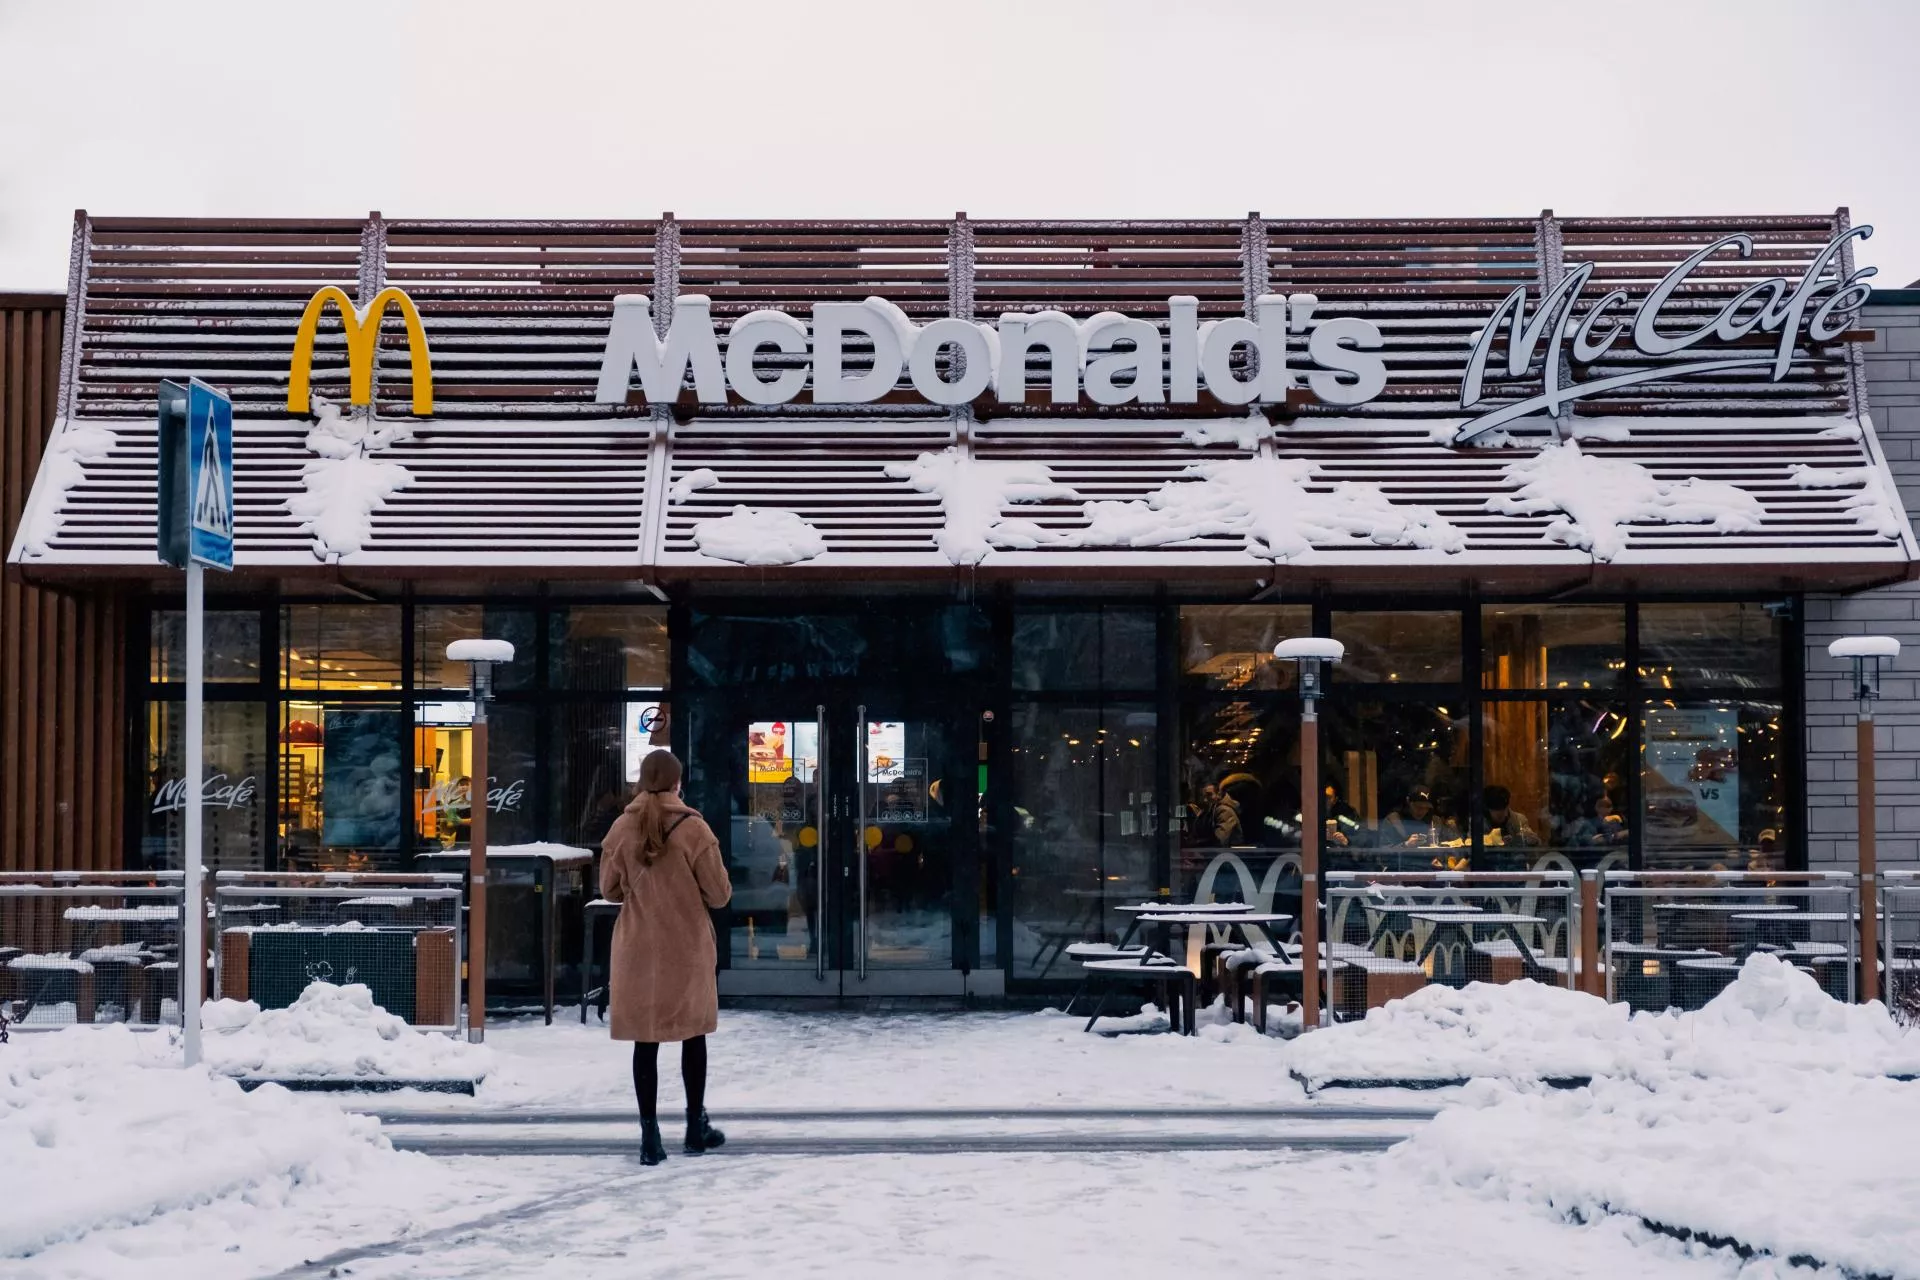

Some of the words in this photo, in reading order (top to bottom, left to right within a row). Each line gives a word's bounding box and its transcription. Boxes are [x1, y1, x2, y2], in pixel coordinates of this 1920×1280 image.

[594, 292, 1388, 407] McDonald's
[1454, 224, 1878, 442] McCafé
[1699, 788, 1720, 800] VS
